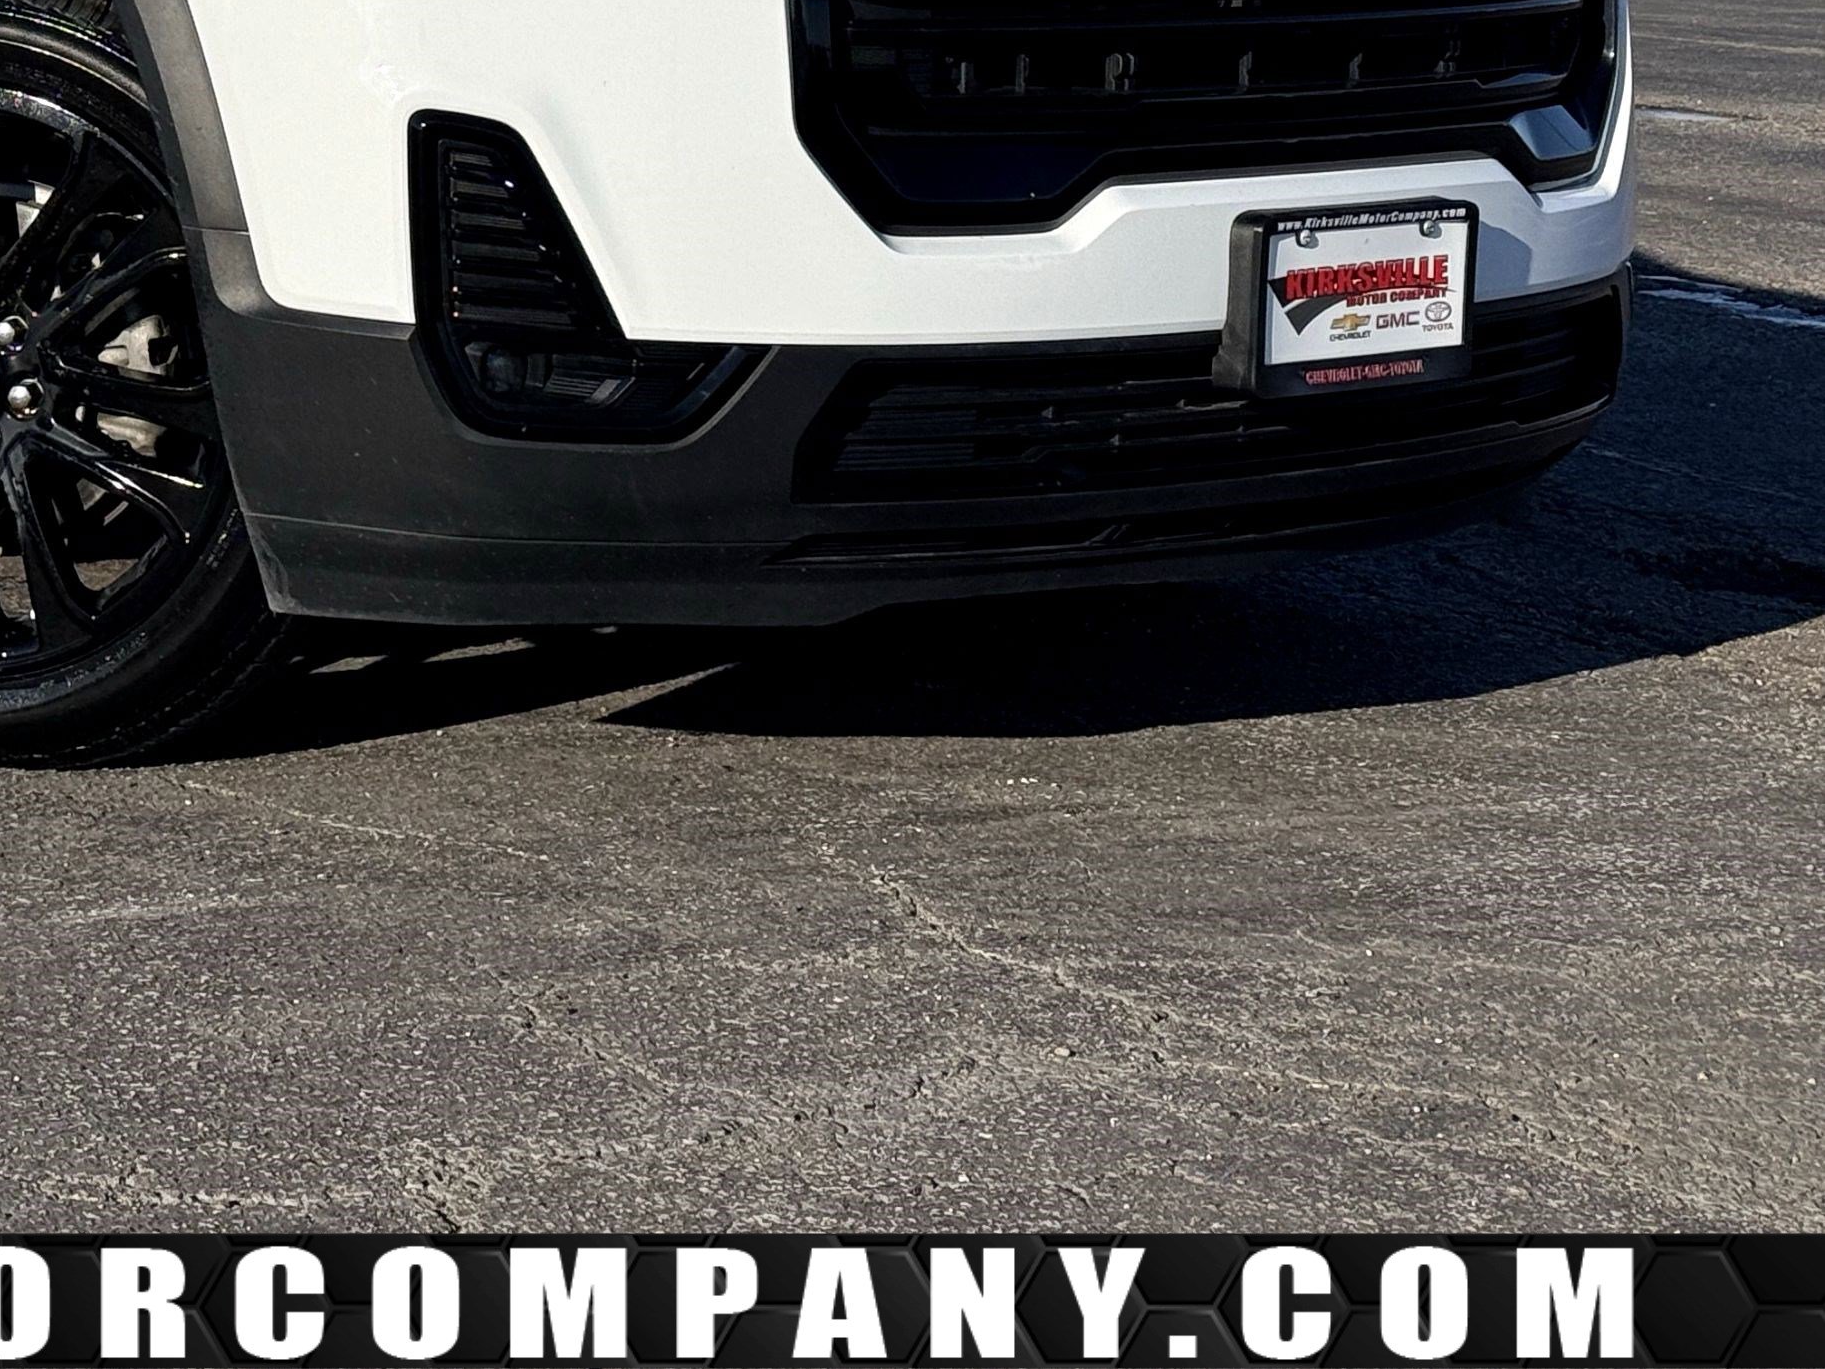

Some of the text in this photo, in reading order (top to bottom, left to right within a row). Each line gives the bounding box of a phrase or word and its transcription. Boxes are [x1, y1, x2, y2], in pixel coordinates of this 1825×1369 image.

[1277, 207, 1466, 231] www.KirksvilleMotorCompany.com
[1285, 254, 1449, 300] KIRKSVILLE
[1346, 286, 1448, 308] MOTOR COMPANY
[1376, 310, 1421, 330] GMC
[1422, 322, 1454, 332] TOYOTA
[1329, 330, 1372, 342] CHEVROLET
